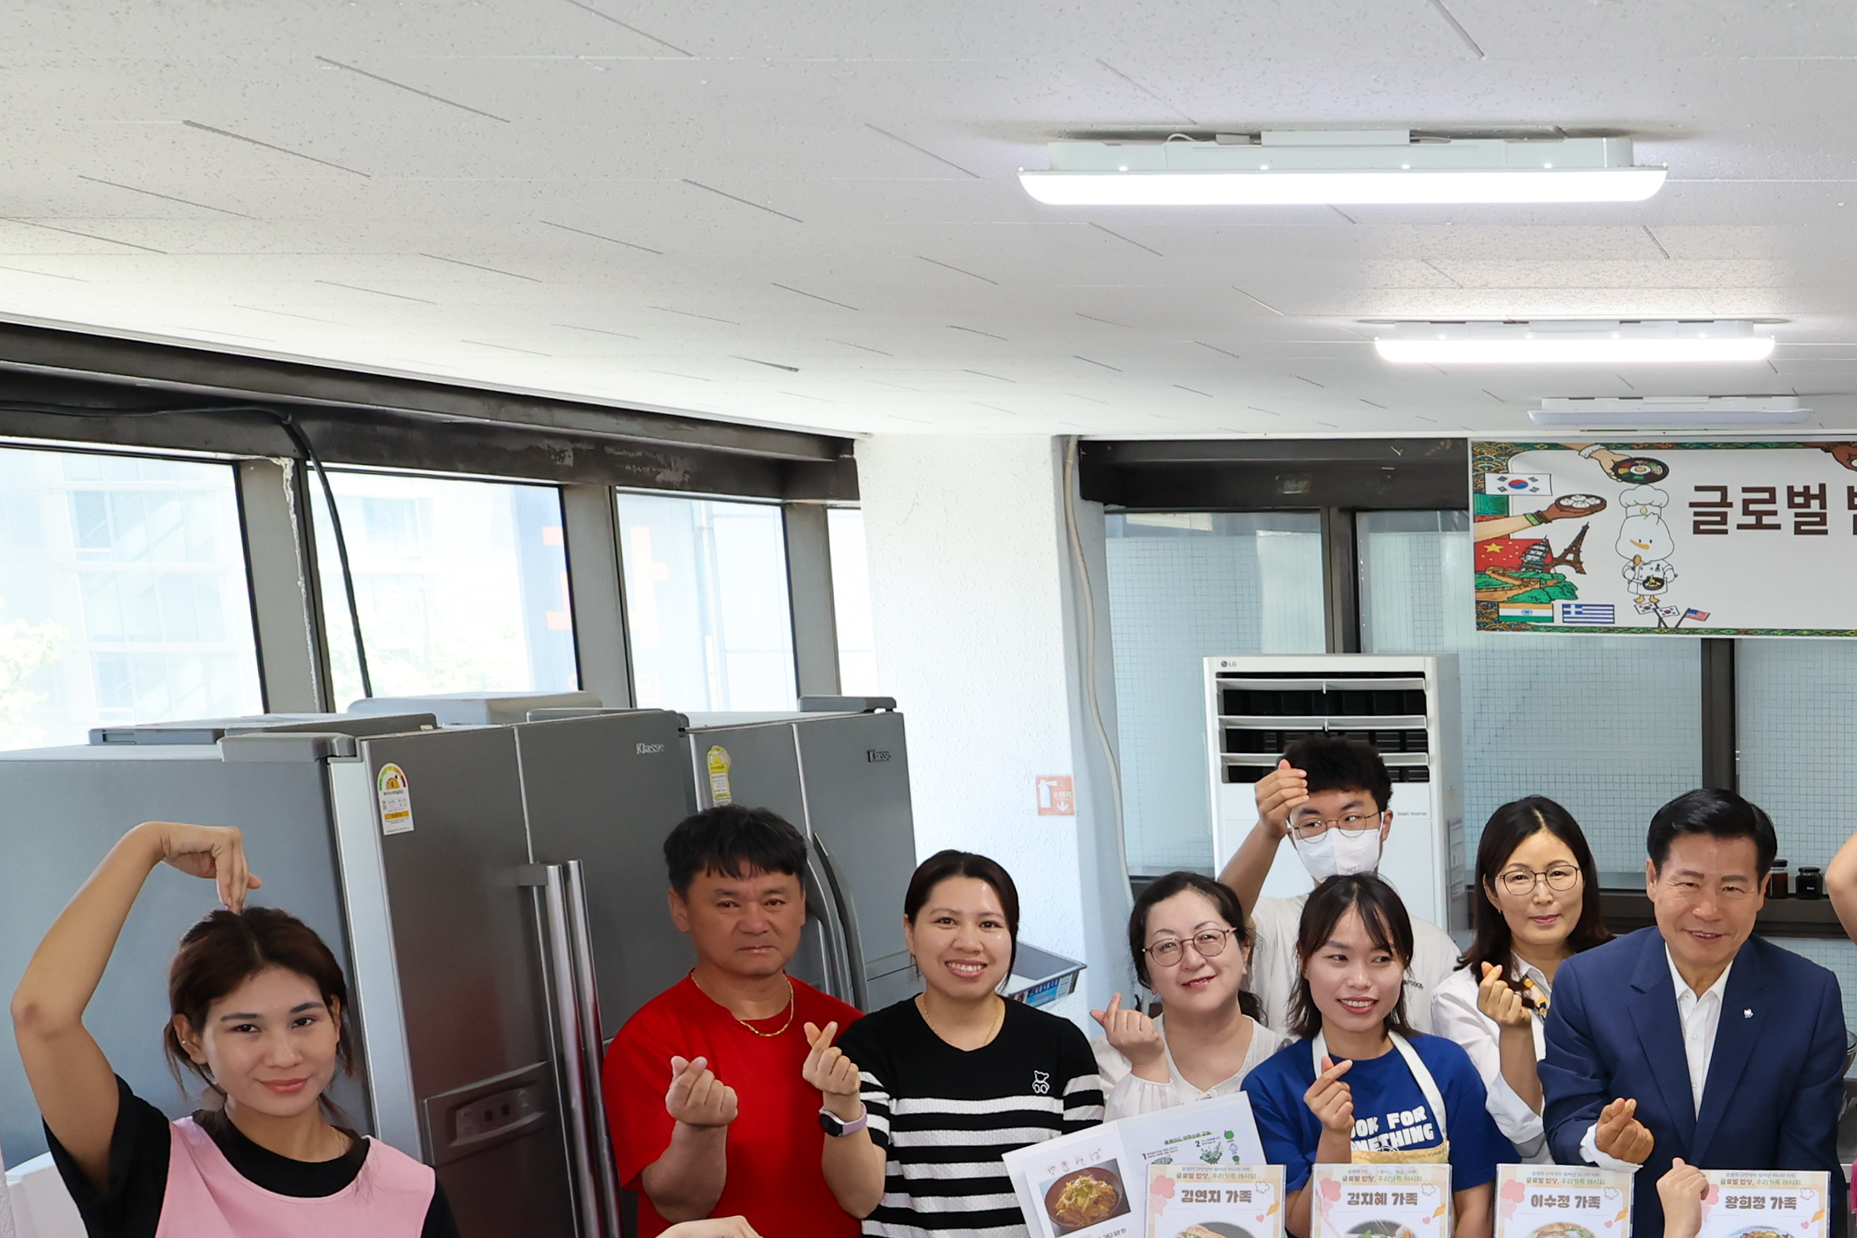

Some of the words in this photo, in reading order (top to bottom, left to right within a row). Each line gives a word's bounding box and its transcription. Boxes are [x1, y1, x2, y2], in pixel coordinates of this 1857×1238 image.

[1689, 483, 1828, 535] 글로벌
[1386, 1105, 1427, 1129] FOR
[1181, 1190, 1220, 1203] 김연지
[1225, 1190, 1252, 1203] 가족
[1347, 1192, 1387, 1206] 김지혜
[1391, 1192, 1418, 1206] 가족
[1531, 1194, 1570, 1208] 이수정
[1574, 1195, 1601, 1209] 가족
[1725, 1195, 1765, 1210] 왕희정
[1770, 1196, 1797, 1210] 가족
